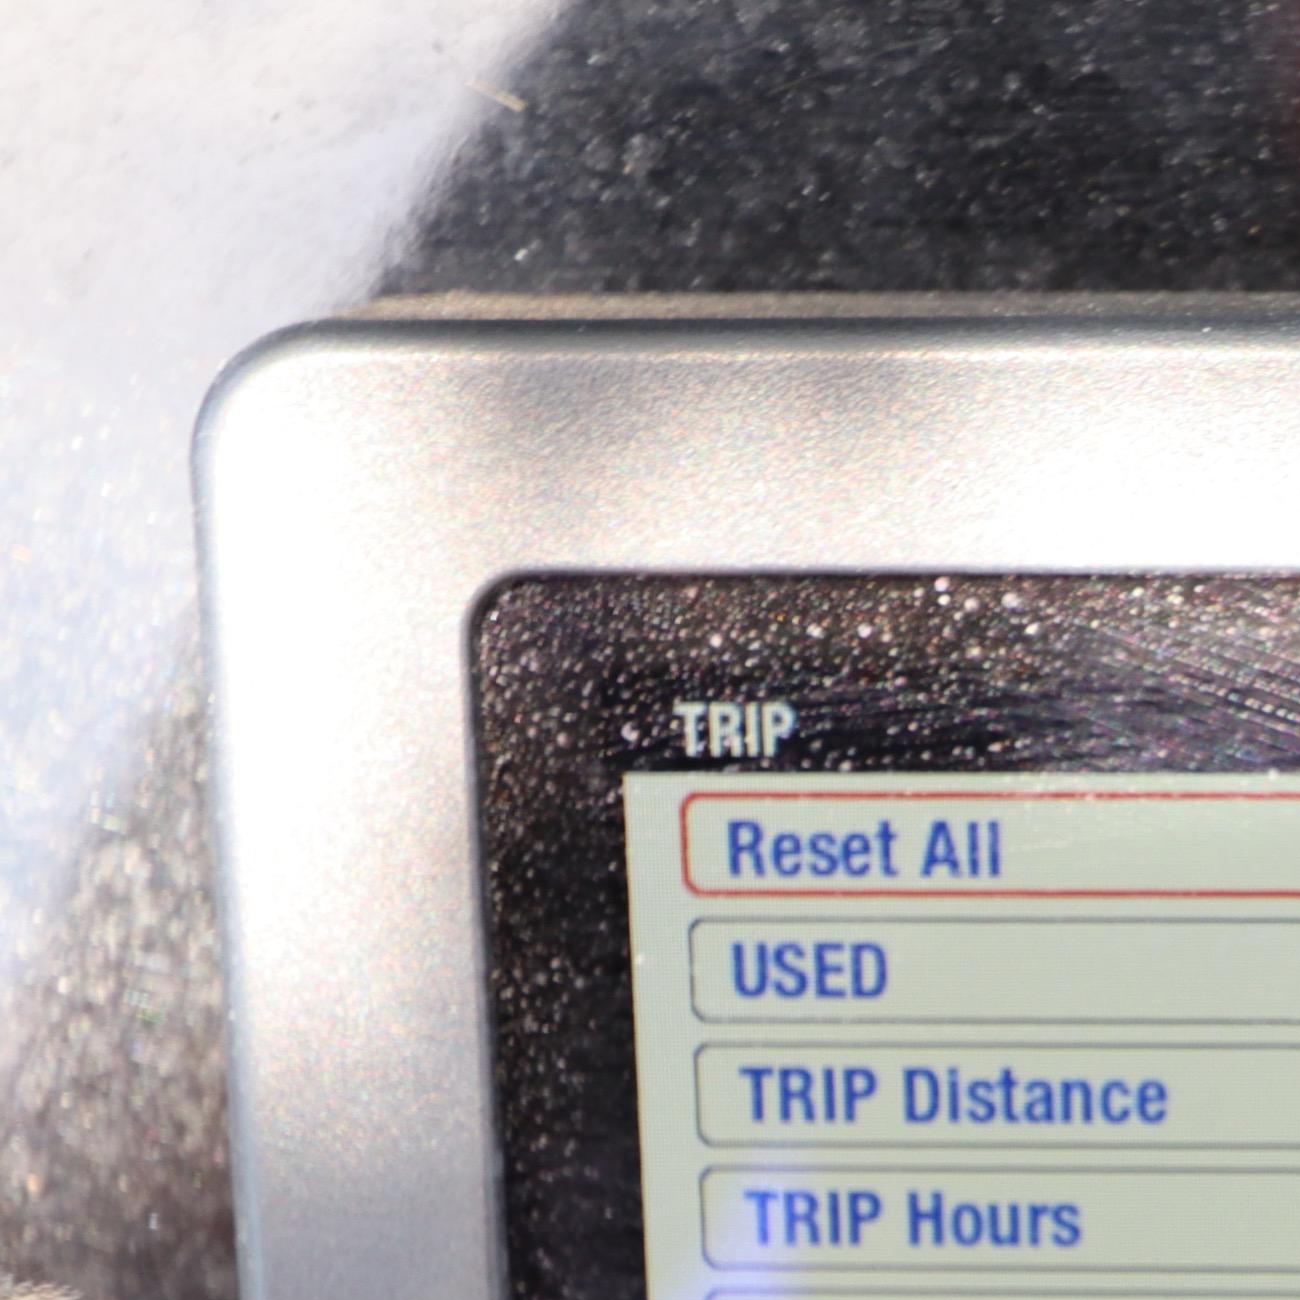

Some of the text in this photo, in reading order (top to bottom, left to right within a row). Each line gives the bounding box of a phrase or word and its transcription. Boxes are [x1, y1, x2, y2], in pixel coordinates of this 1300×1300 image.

[673, 702, 797, 757] TRIP
[727, 820, 1001, 878] Reset All
[732, 942, 888, 1000] USED
[739, 1066, 1169, 1124] TRIP Distance
[744, 1190, 1082, 1248] TRIP Hours
